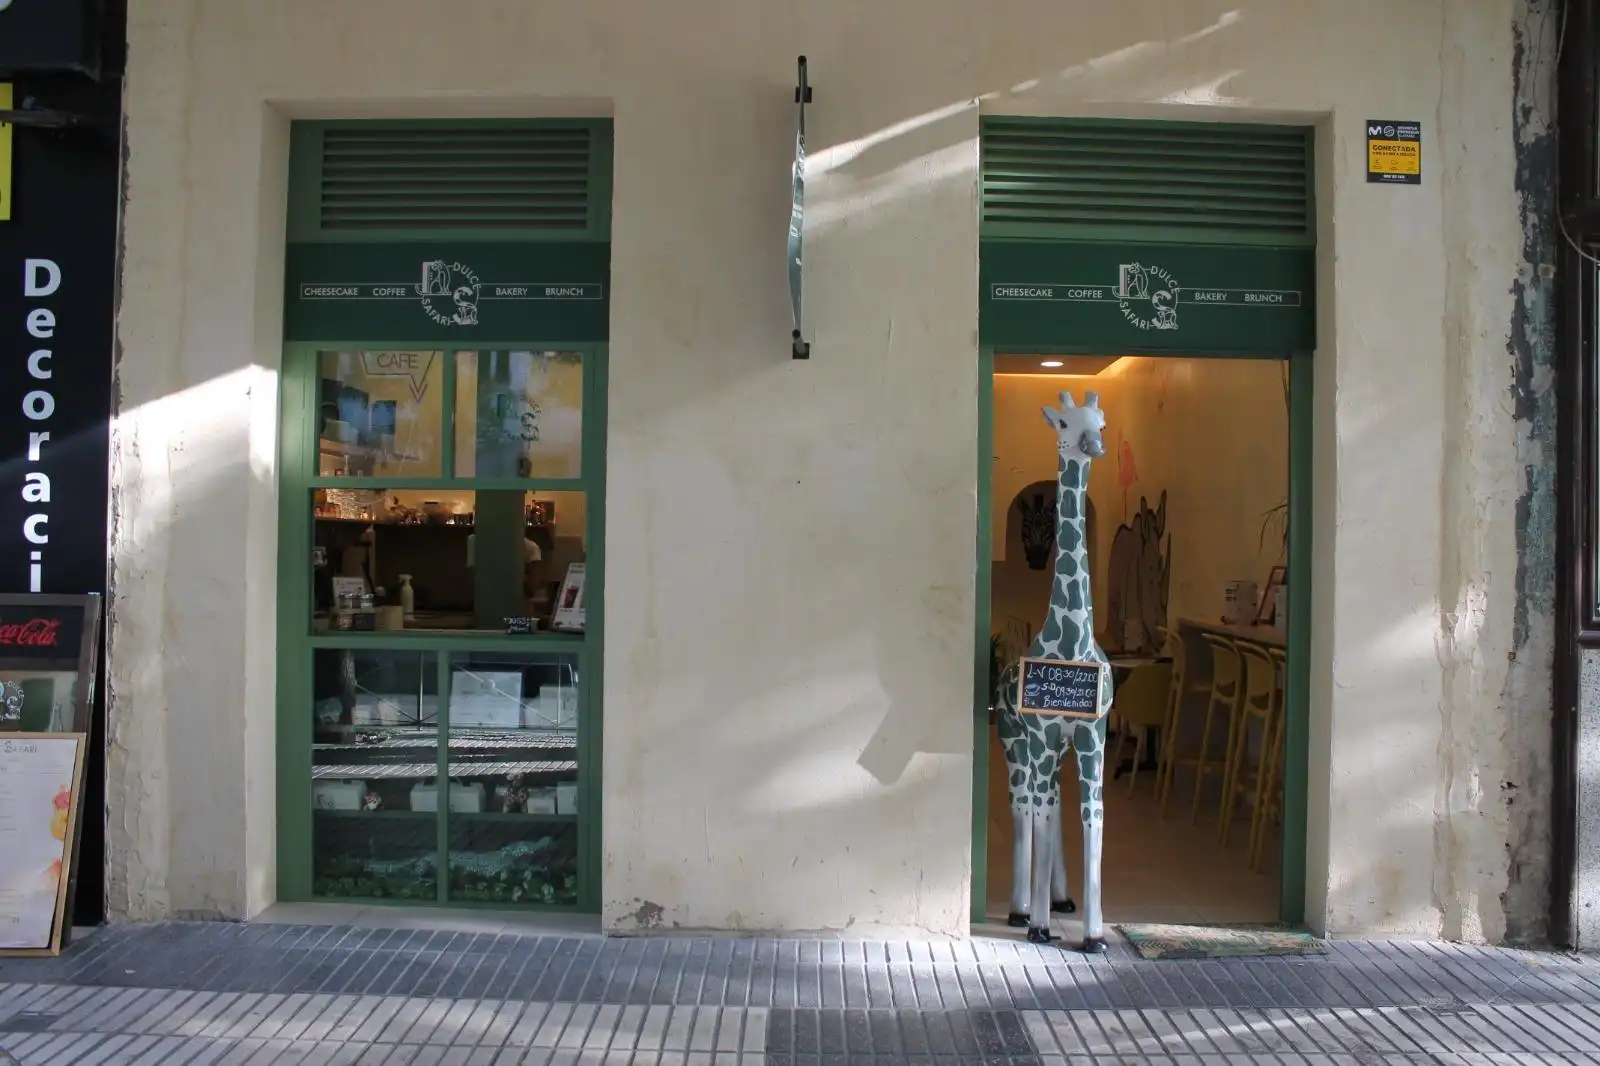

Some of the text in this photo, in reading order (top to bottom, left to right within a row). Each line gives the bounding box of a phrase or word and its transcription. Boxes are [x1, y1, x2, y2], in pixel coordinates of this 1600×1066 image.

[1372, 145, 1416, 153] CONECTADA
[452, 261, 483, 291] DULCE
[1150, 265, 1181, 295] DULCE
[304, 287, 406, 297] CHEESECAKE COFFEE
[495, 287, 584, 297] BAKERY BRUNCH
[995, 287, 1103, 299] CHEESECAKE COFFEE
[1194, 291, 1283, 303] BAKERY BRUNCH
[420, 297, 451, 327] SAFARI
[1118, 300, 1150, 330] SAFARI
